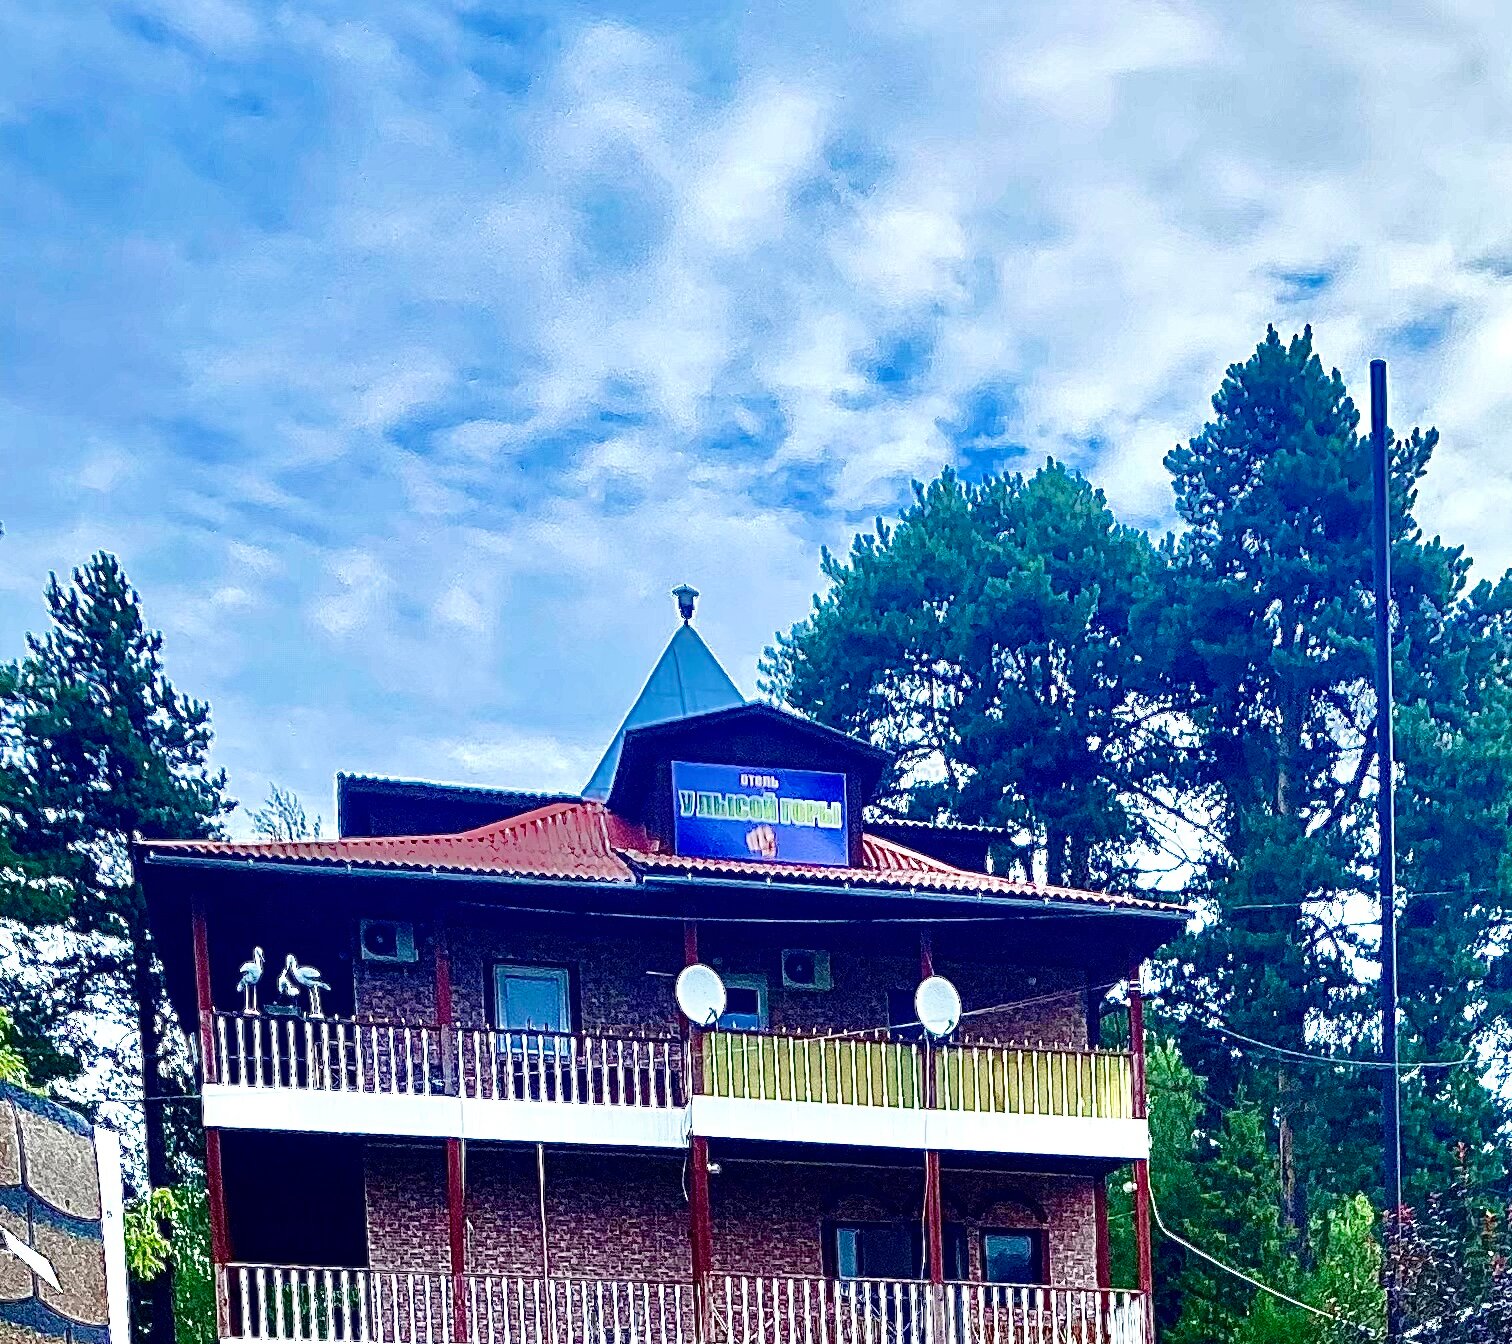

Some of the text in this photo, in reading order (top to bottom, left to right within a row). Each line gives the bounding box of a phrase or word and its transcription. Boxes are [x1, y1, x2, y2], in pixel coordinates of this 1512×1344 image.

[678, 789, 843, 829] У ЛЫСОЙ ГОРЫ
